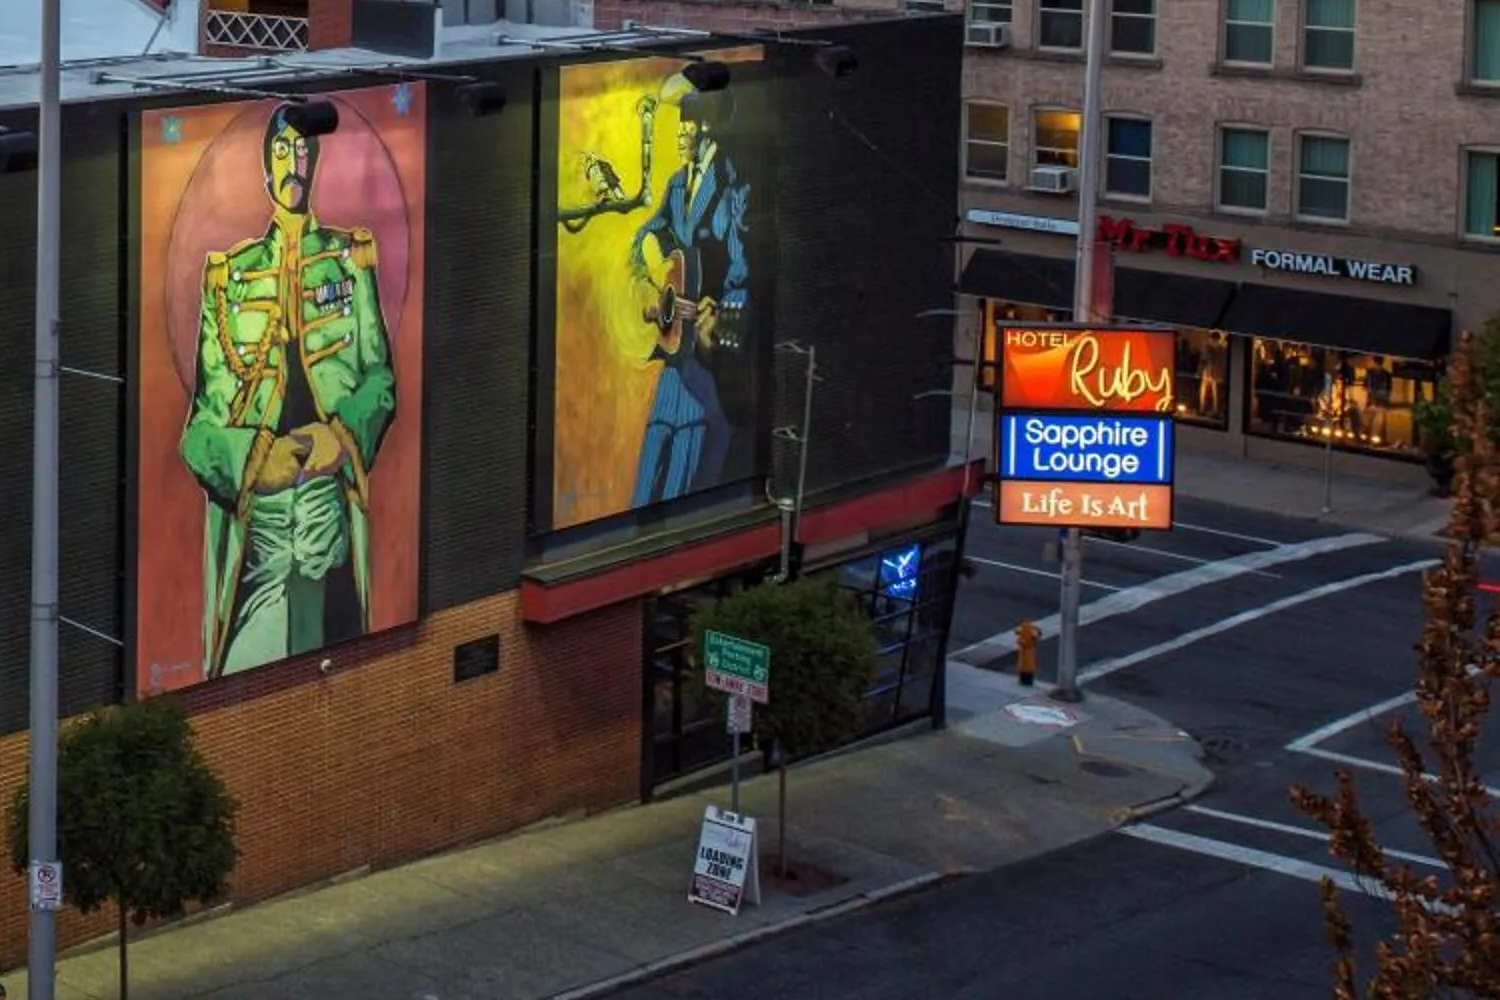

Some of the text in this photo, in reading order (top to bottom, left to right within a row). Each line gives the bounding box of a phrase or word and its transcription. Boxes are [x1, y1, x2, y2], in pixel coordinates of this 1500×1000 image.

[1162, 222, 1241, 262] Tux
[1251, 249, 1413, 285] FORMAL WEAR
[1007, 331, 1073, 348] HOTEL
[1071, 335, 1174, 411] Ruby
[1025, 419, 1148, 449] Sapphire
[1033, 447, 1140, 478] Lounge
[1022, 488, 1149, 521] Life Is Art
[700, 845, 744, 870] LOADING
